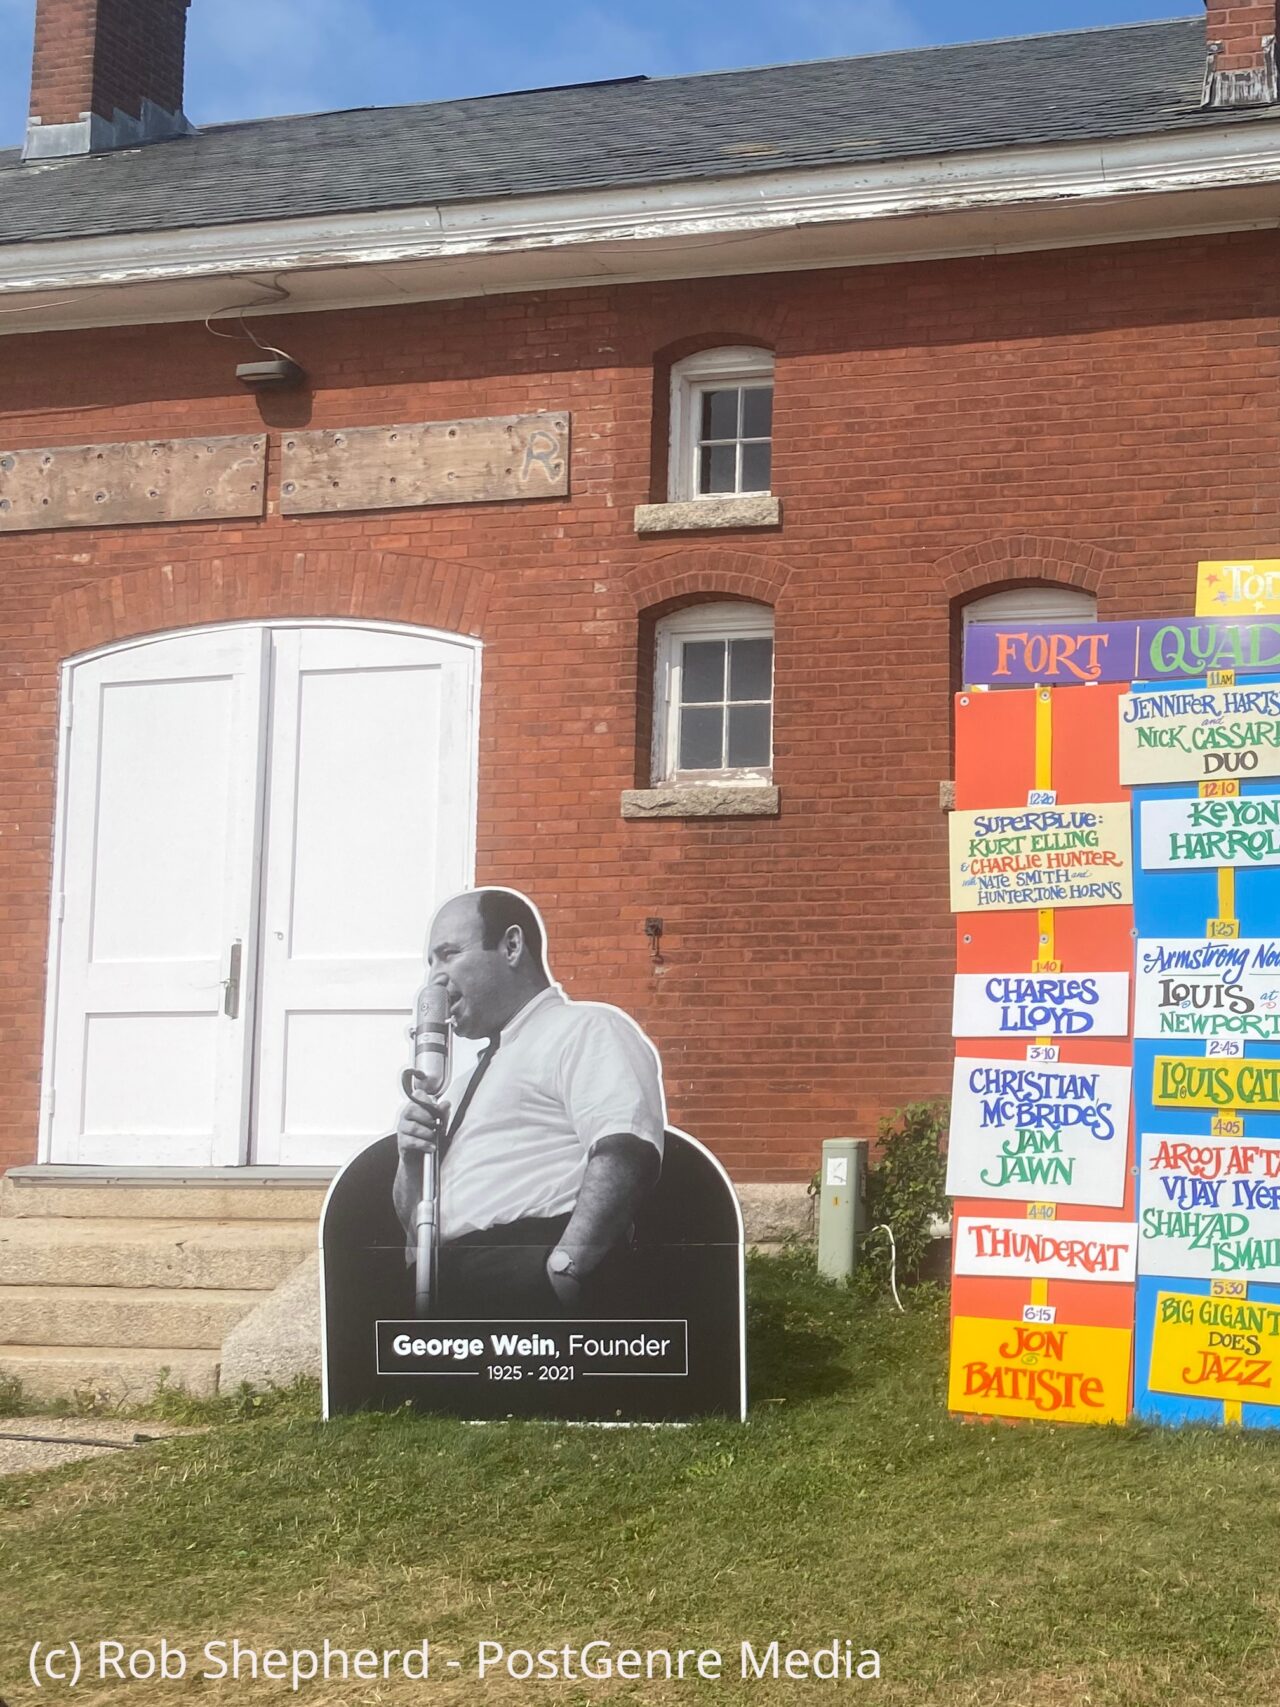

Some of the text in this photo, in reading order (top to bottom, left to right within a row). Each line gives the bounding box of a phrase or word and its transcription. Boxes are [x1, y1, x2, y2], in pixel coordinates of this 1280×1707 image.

[992, 632, 1109, 680] FORT
[1201, 717, 1224, 726] and
[1135, 725, 1193, 753] NICK
[1203, 751, 1259, 774] DUO
[968, 830, 1099, 857] KURT ELLING
[1016, 869, 1071, 886] SMITH
[1071, 870, 1093, 879] and
[1069, 882, 1122, 899] HORNS
[1143, 942, 1250, 985] Armstrong
[1158, 978, 1279, 1014] LOUIS at
[999, 1005, 1094, 1034] LLOYD
[1209, 1041, 1239, 1055] 2:45
[969, 1068, 1099, 1103] CHRISTIAN
[1159, 1062, 1234, 1104] LOUIS
[1002, 1129, 1063, 1155] JAM
[980, 1155, 1076, 1186] JAWN
[1149, 1141, 1225, 1179] AROOJ
[1160, 1176, 1227, 1210] VIJAY
[1143, 1208, 1250, 1250] SHAHZAD
[1024, 1307, 1052, 1322] 6:15
[1161, 1298, 1194, 1325] BIG
[393, 1333, 670, 1360] George Wein, Founder
[999, 1327, 1068, 1361] JON
[1208, 1332, 1261, 1355] DOES
[487, 1366, 574, 1380] 1925 2021
[1182, 1351, 1272, 1388] JAZZ
